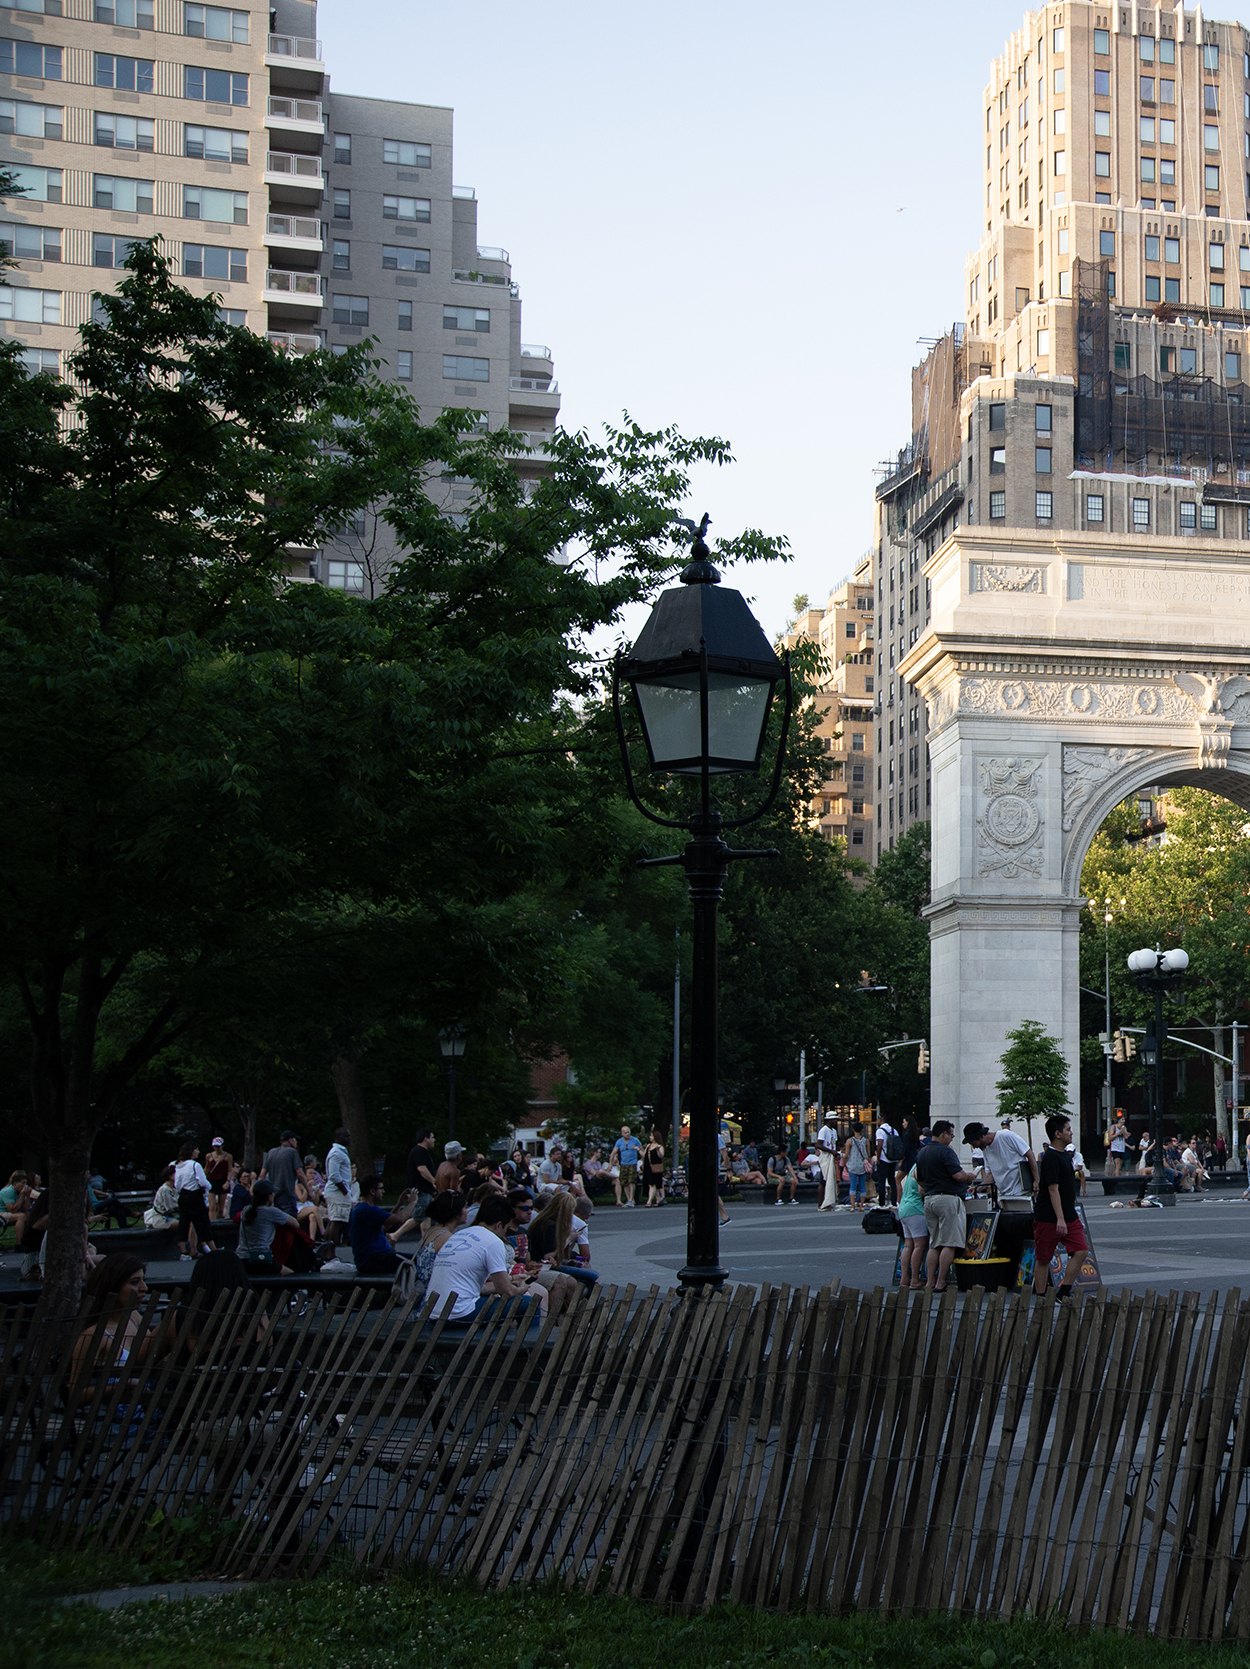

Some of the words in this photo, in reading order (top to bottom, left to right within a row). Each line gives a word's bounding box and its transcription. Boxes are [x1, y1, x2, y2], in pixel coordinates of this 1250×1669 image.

[1077, 567, 1098, 577] LET
[1101, 569, 1114, 578] US
[1117, 570, 1149, 580] RAISE
[1153, 571, 1162, 580] A
[1165, 572, 1225, 584] STANDARD
[1229, 575, 1244, 584] TO
[1077, 578, 1100, 587] AND
[1104, 579, 1127, 589] THE
[1133, 581, 1179, 591] HONEST
[1185, 583, 1210, 592] CAN
[1077, 587, 1087, 597] IS
[1090, 588, 1102, 597] IN
[1106, 589, 1129, 599] THE
[1135, 591, 1168, 600] HAND
[1172, 592, 1187, 602] OF
[1193, 593, 1217, 603] GOD
